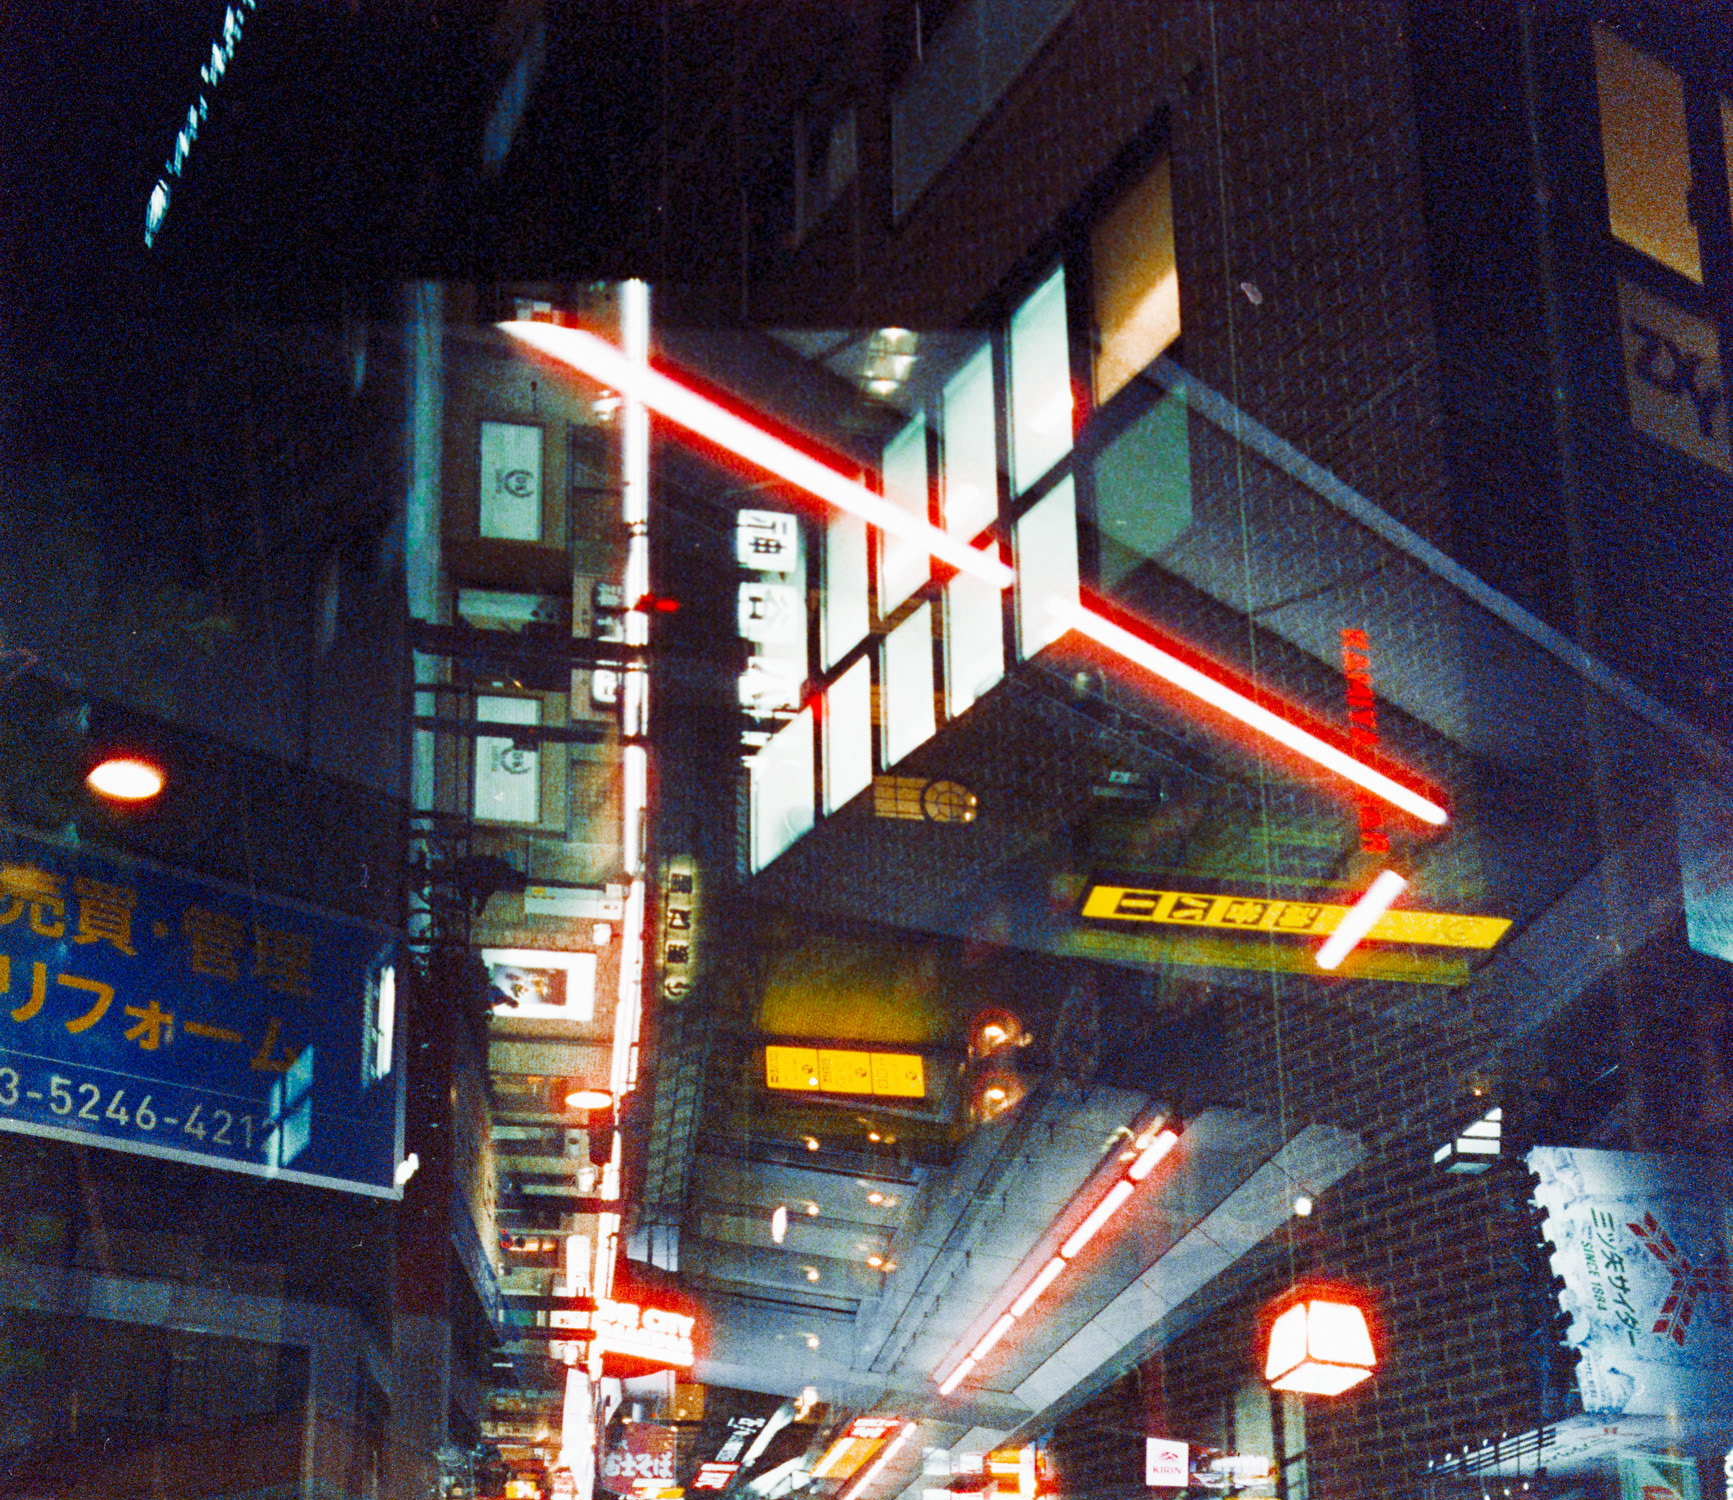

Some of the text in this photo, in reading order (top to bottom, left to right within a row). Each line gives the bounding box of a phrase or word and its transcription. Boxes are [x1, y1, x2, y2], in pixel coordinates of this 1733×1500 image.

[0, 955, 300, 1073] リフォーム
[1582, 1240, 1602, 1277] SINCE
[1590, 1207, 1640, 1347] 三ツ矢サイダー
[1590, 1282, 1608, 1311] 1884
[1152, 1465, 1182, 1475] KIRIN
